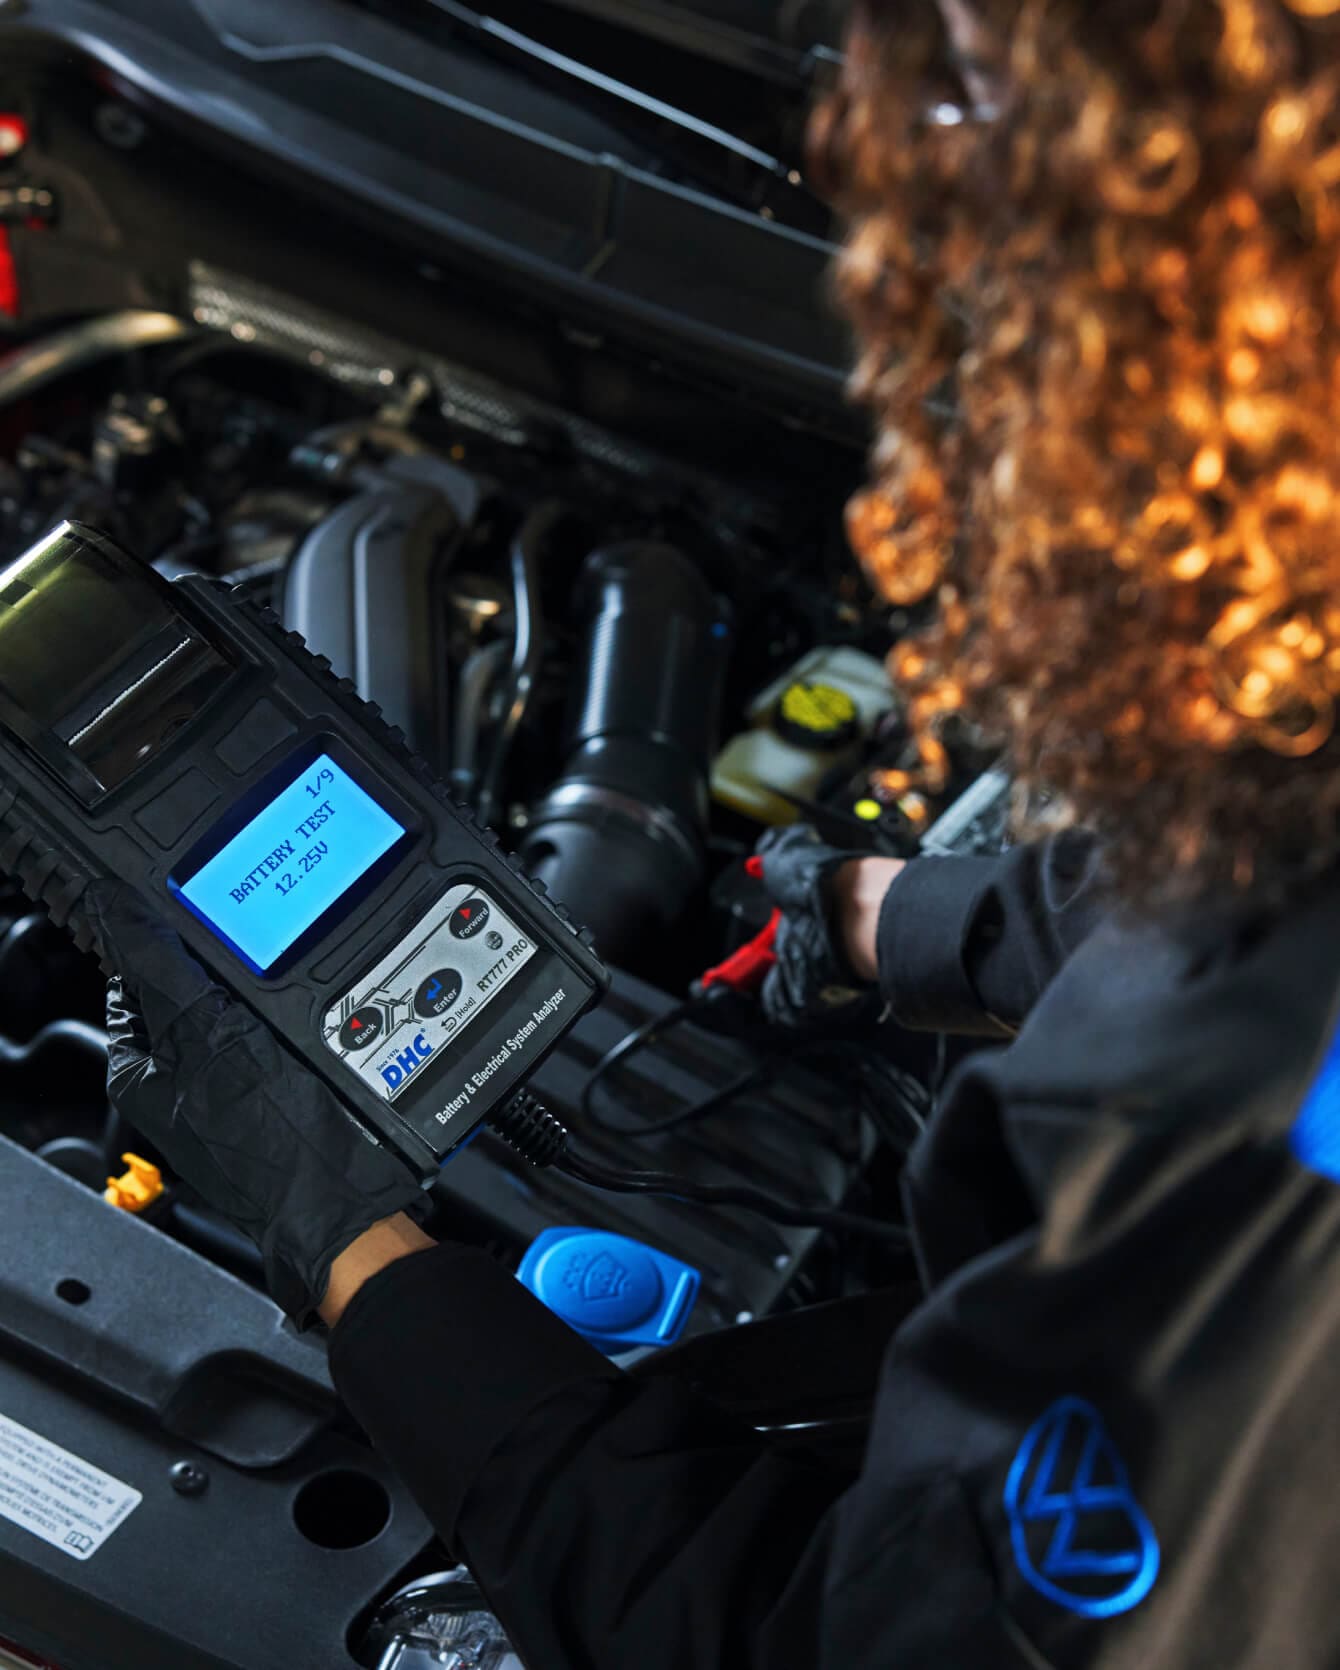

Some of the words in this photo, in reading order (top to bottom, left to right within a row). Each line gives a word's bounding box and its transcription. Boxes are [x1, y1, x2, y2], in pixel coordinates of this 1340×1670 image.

[306, 768, 334, 799] 1/9
[229, 840, 295, 904] BATTERY
[295, 801, 336, 839] TEST
[275, 841, 328, 896] 12.25V
[459, 908, 489, 938] Forward
[476, 958, 508, 992] RT777
[506, 940, 528, 962] PRO
[435, 988, 457, 1013] Enter
[354, 1024, 376, 1044] Back
[435, 1091, 471, 1124] Battery
[467, 1081, 477, 1094] &
[472, 1045, 511, 1087] Electrical
[507, 1020, 537, 1052] System
[534, 988, 566, 1025] Analyzer
